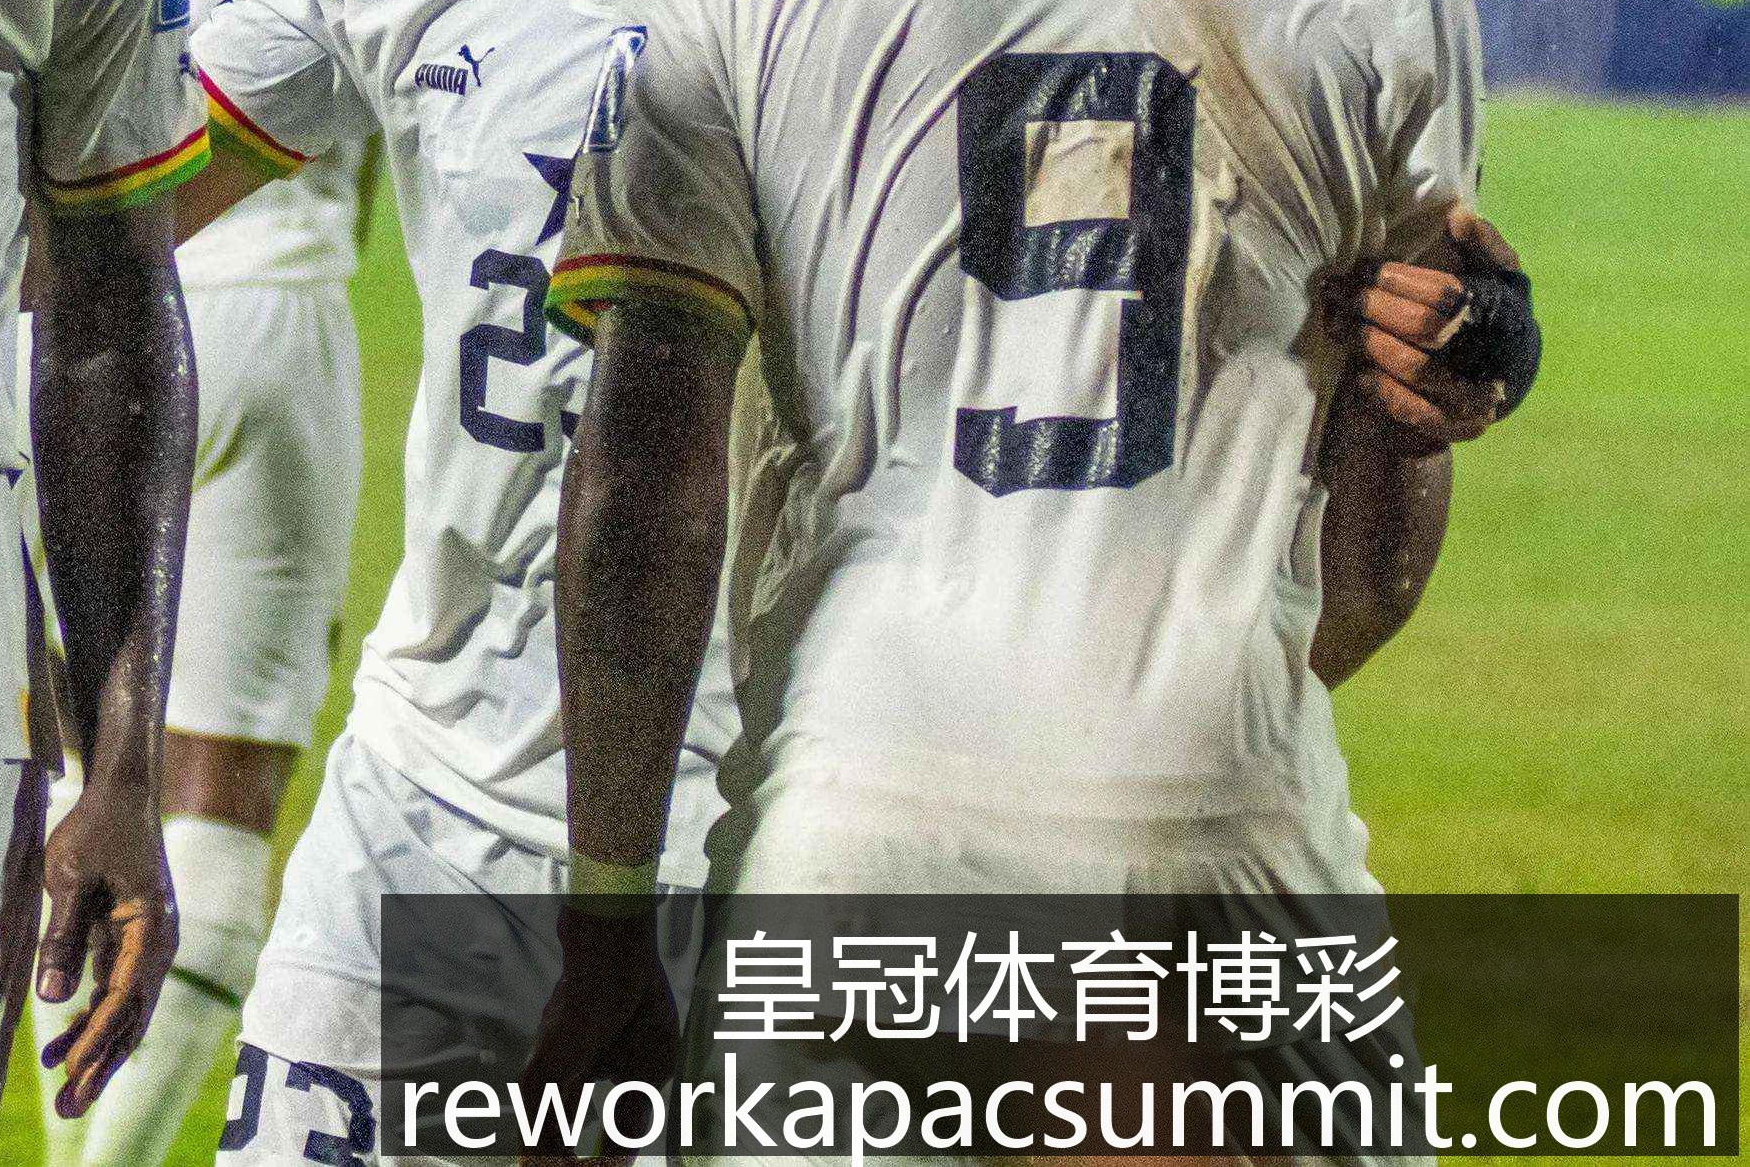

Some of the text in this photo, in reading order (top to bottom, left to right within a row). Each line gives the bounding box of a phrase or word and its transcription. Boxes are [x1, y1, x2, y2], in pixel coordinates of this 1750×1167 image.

[414, 63, 468, 97] PUMA
[459, 248, 580, 452] 2
[954, 51, 1198, 498] 9
